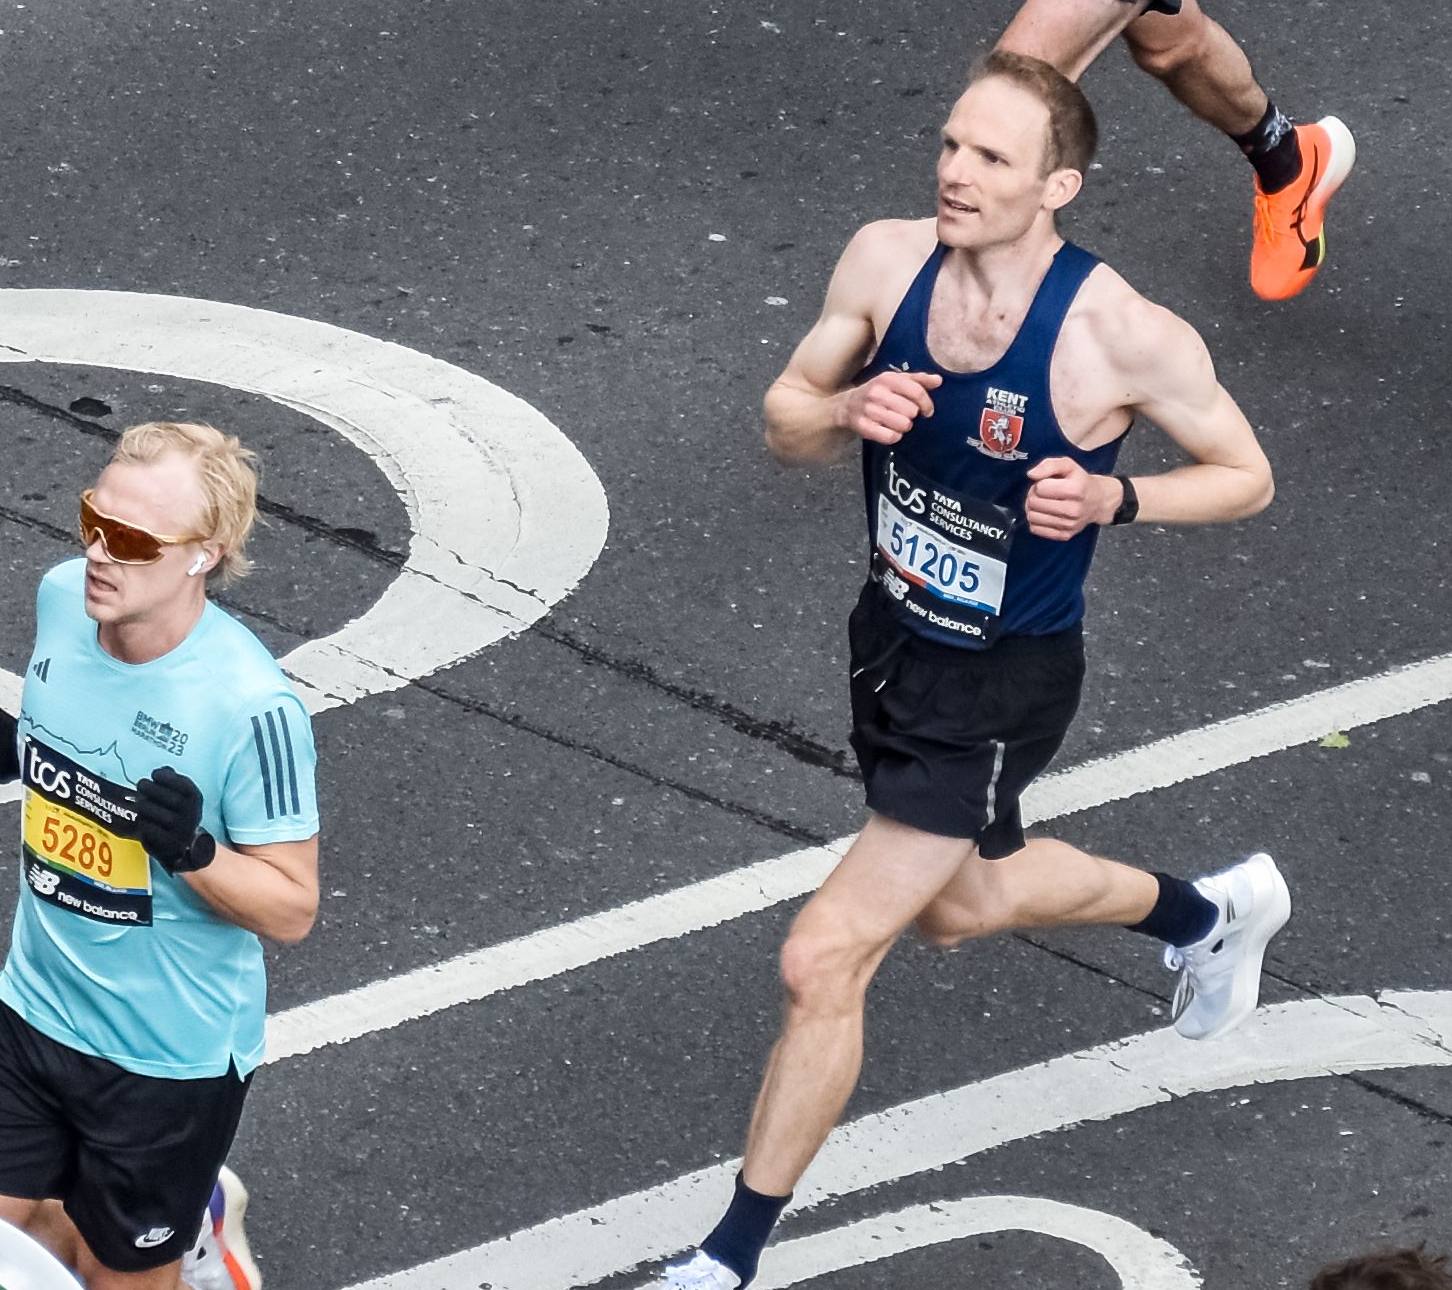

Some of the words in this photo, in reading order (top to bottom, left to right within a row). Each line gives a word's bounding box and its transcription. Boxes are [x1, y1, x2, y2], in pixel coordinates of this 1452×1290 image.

[987, 387, 1029, 407] KENT
[889, 462, 927, 514] tcs
[932, 490, 962, 513] TATA
[929, 512, 973, 541] SERVICES
[931, 502, 1004, 540] CONSULTANCY
[891, 522, 980, 593] 51205
[905, 598, 928, 618] new
[928, 610, 982, 636] balance
[167, 741, 184, 757] 23
[172, 730, 189, 745] 20
[29, 747, 71, 799] tcs
[76, 771, 101, 794] TATA
[75, 784, 138, 822] CONSULTANCY
[75, 795, 113, 824] SERVICES
[42, 816, 114, 878] 5289
[57, 891, 82, 908] new
[82, 900, 138, 920] balance
